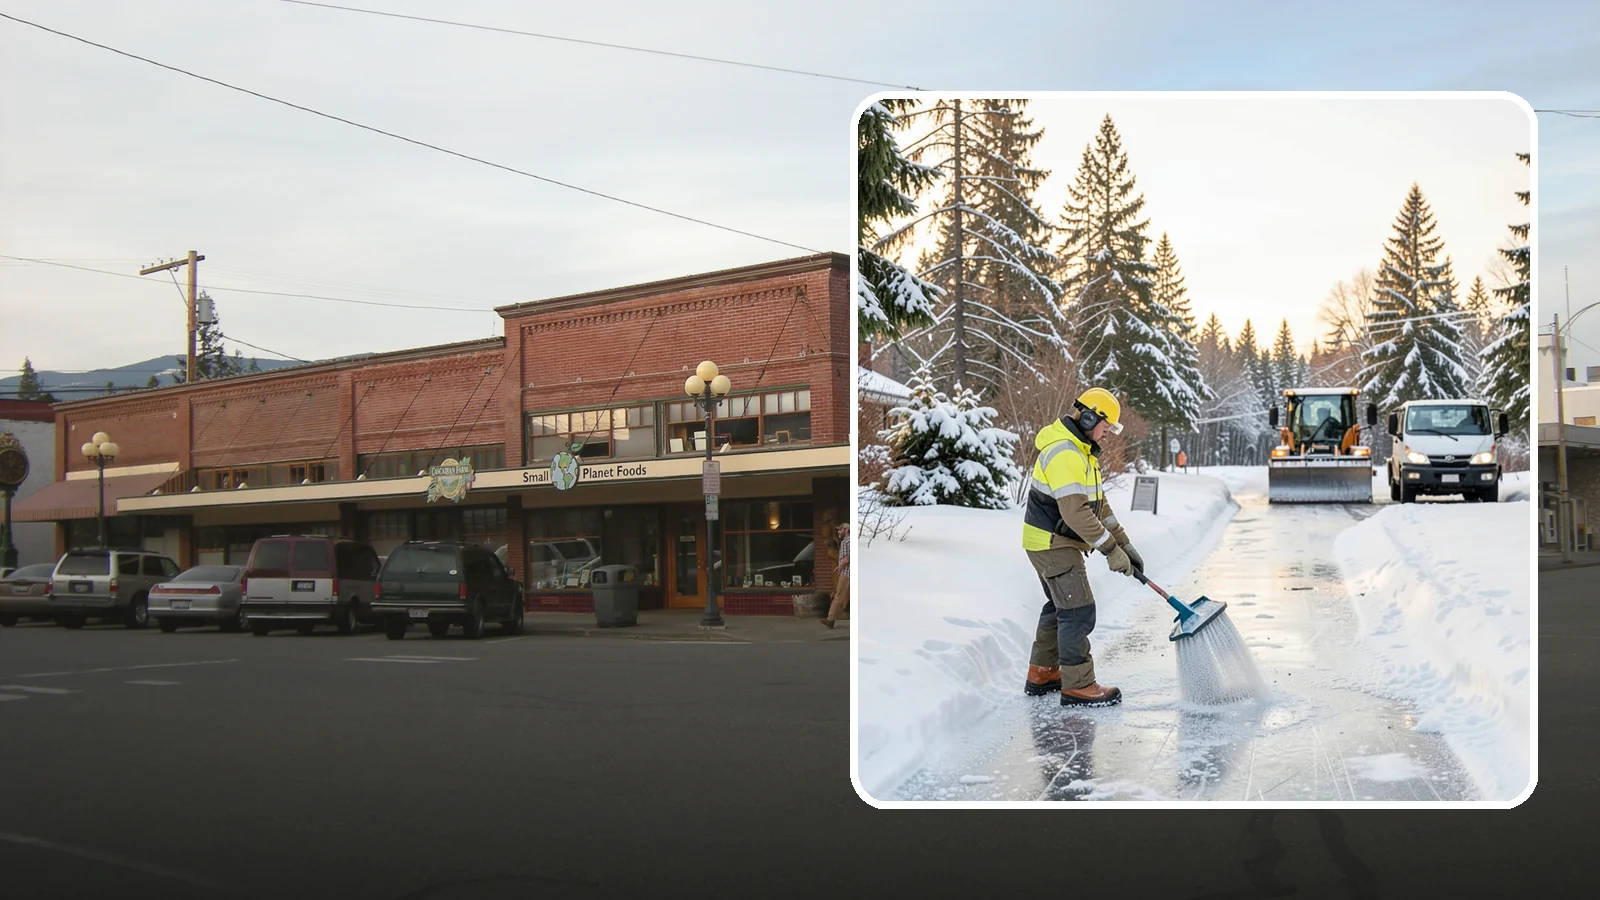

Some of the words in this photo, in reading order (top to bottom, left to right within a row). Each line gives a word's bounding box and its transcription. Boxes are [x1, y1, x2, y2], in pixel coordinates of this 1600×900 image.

[522, 470, 549, 483] Small
[582, 467, 614, 479] Planet
[616, 464, 647, 477] Foods
